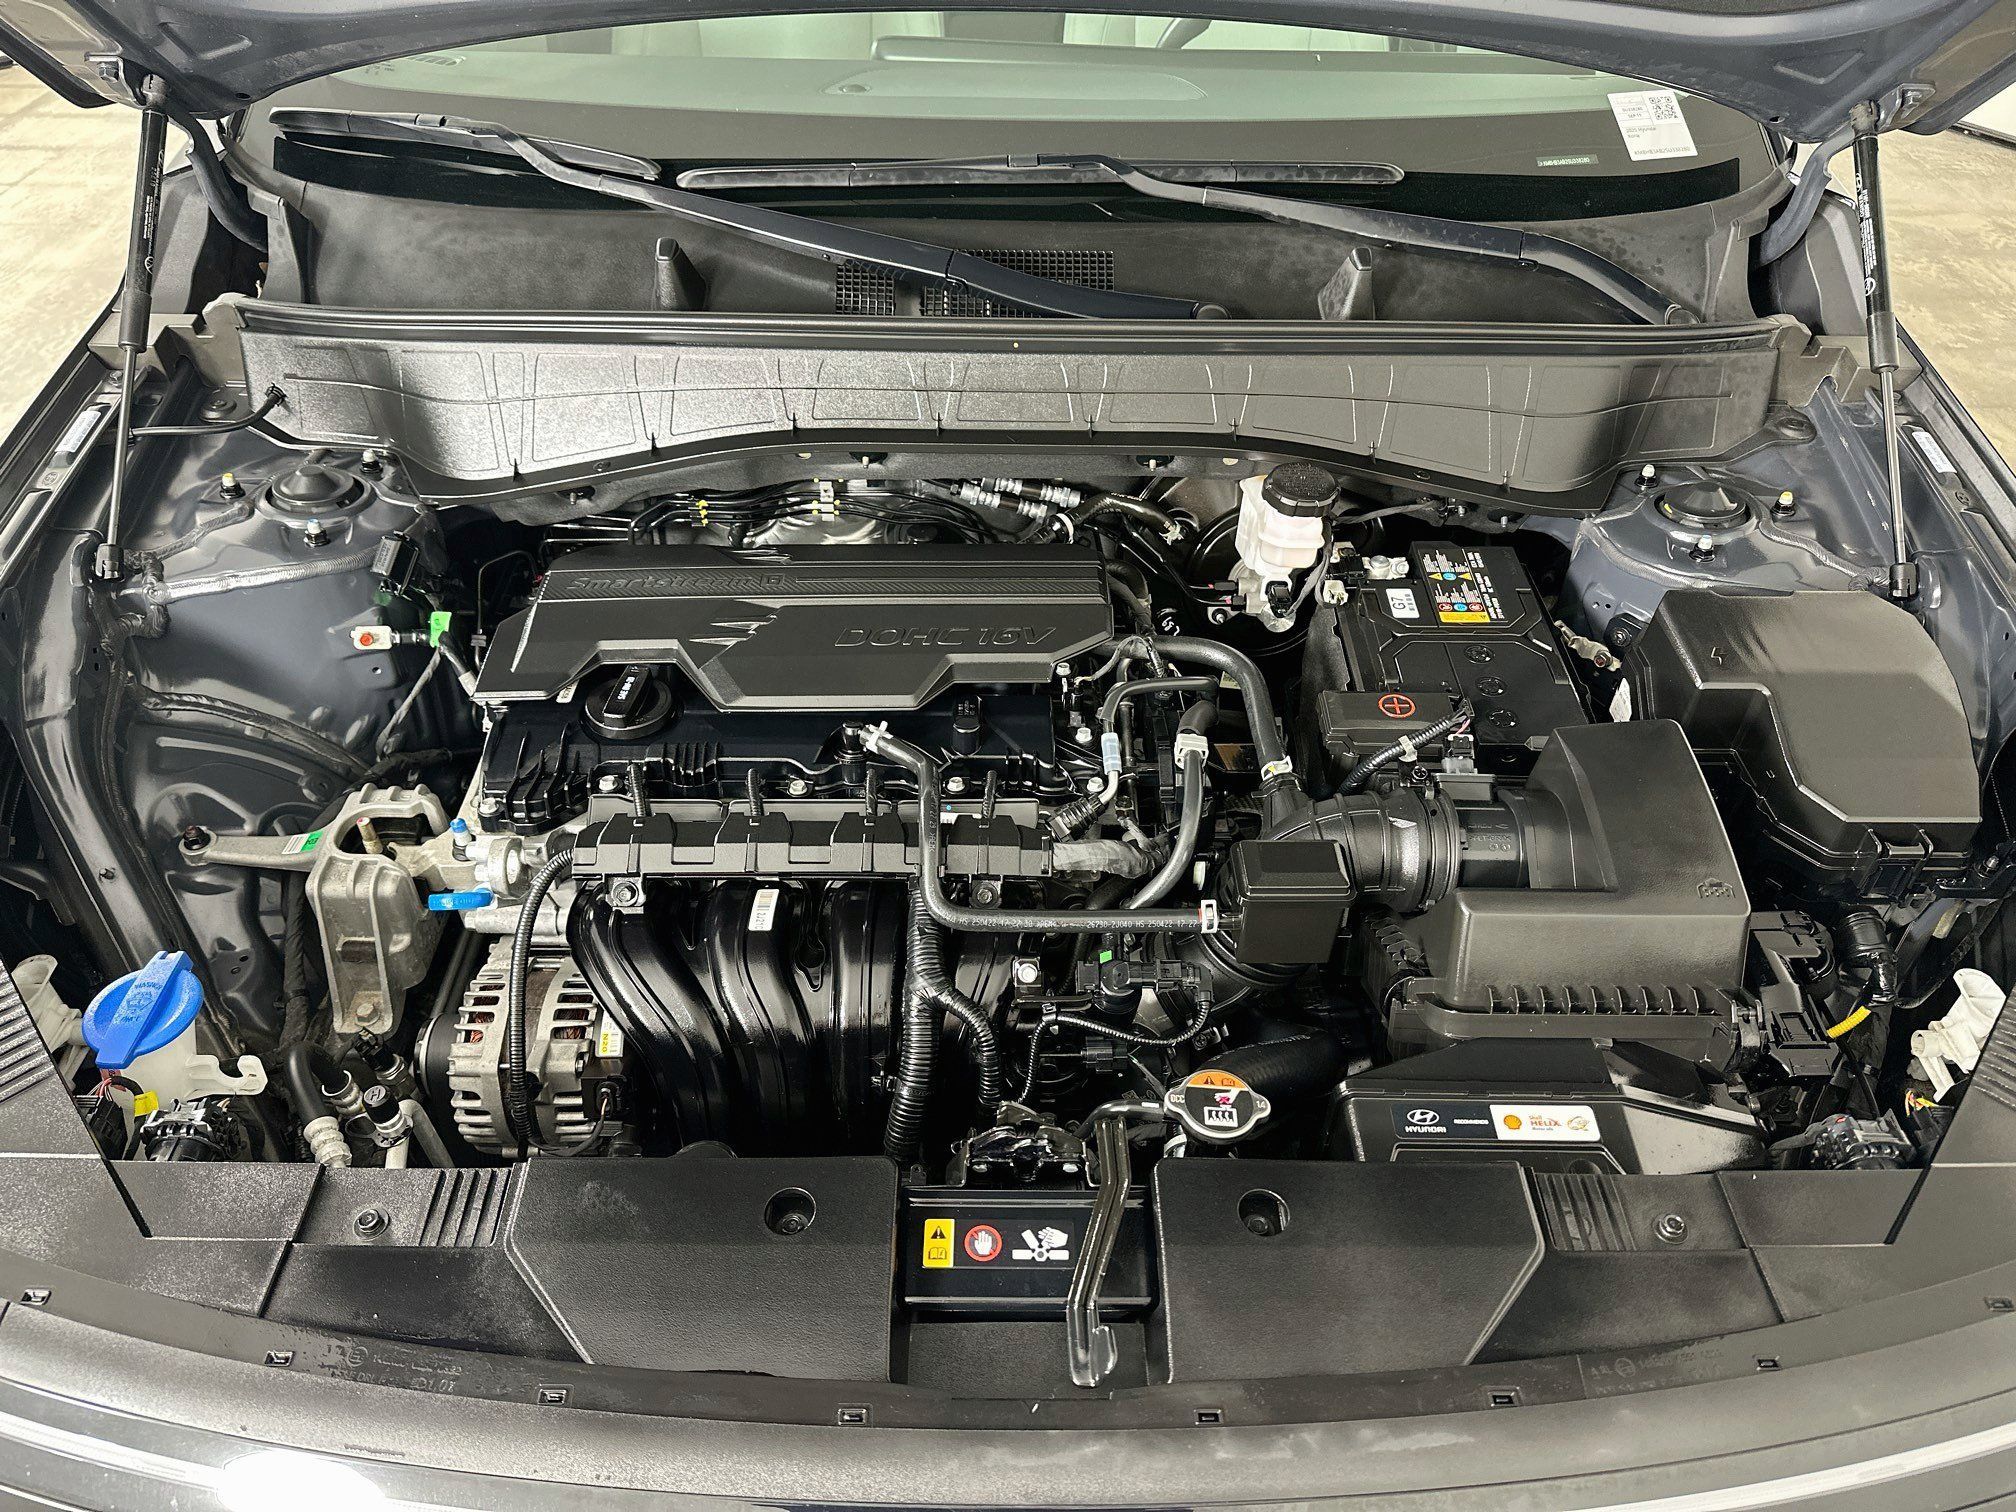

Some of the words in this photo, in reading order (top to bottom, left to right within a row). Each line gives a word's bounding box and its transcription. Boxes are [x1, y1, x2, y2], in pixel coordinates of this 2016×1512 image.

[566, 575, 753, 589] Smartstream
[1391, 596, 1406, 610] G7
[834, 628, 970, 647] DOHC
[978, 628, 1057, 645] 16V
[1135, 920, 1145, 928] HS
[1148, 919, 1173, 928] 250422
[1530, 1119, 1562, 1127] HELIX
[1405, 1126, 1447, 1134] HYUNDAI
